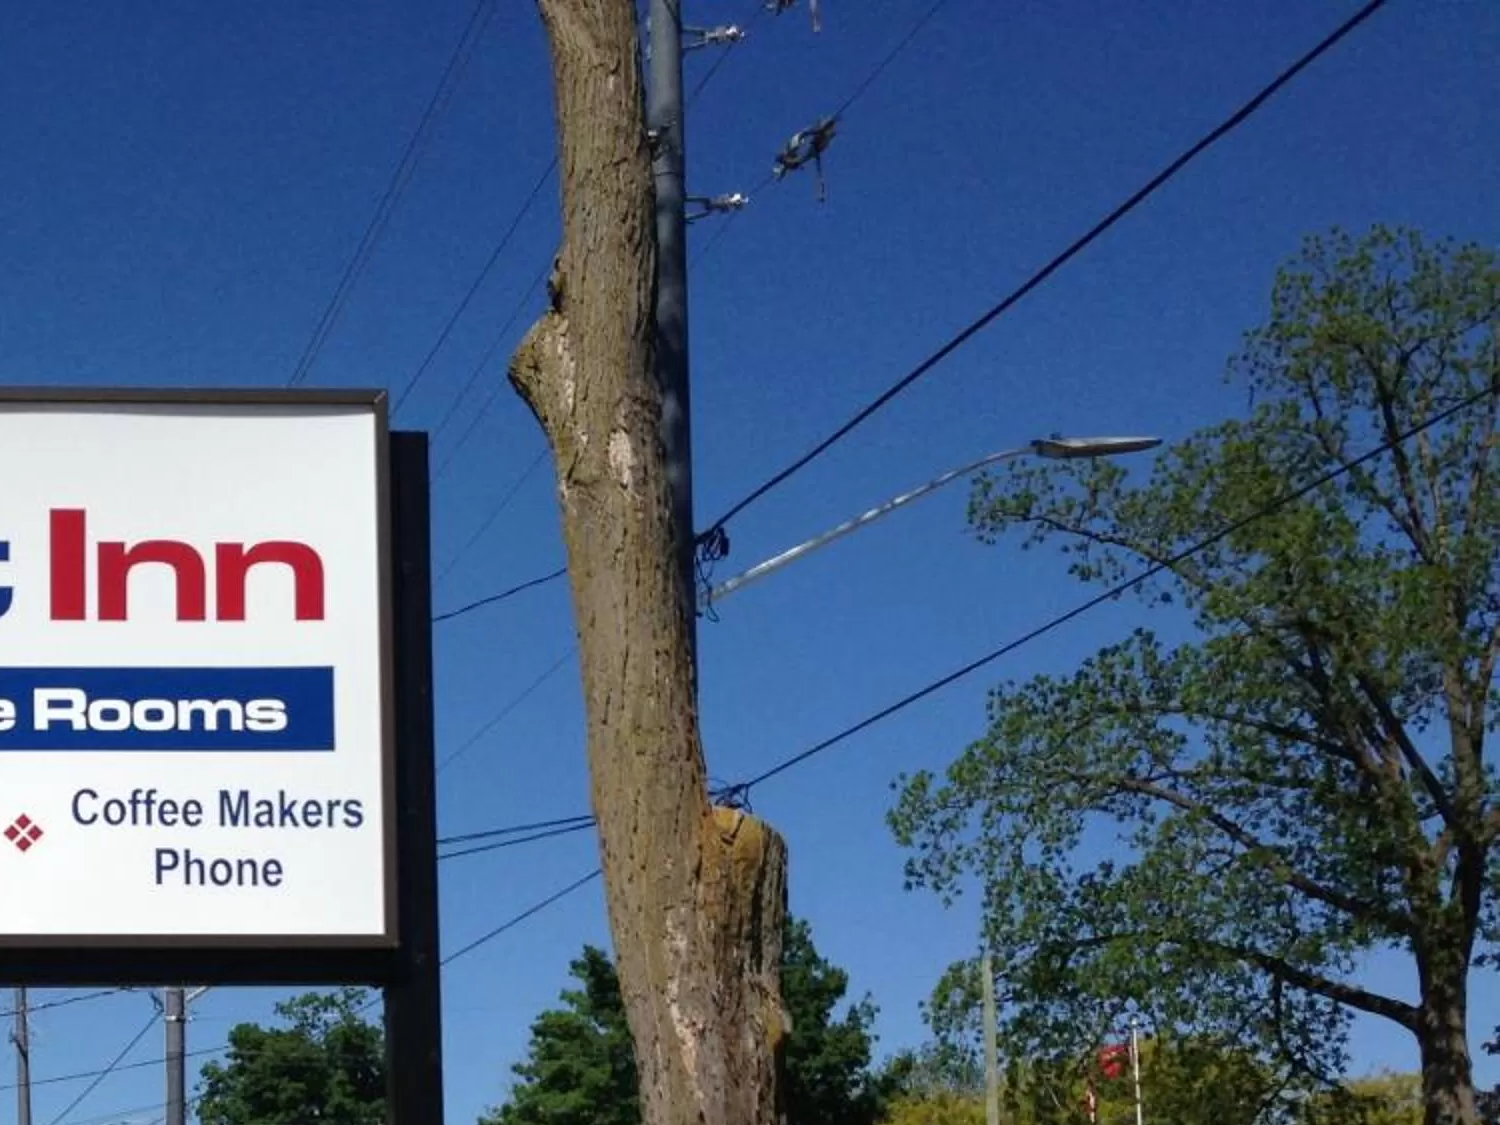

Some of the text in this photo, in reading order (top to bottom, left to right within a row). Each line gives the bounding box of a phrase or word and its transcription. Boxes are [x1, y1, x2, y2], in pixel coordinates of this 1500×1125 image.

[50, 509, 325, 622] Inn
[33, 687, 288, 732] Rooms
[71, 789, 364, 829] Coffee Makers
[155, 848, 284, 888] Phone
